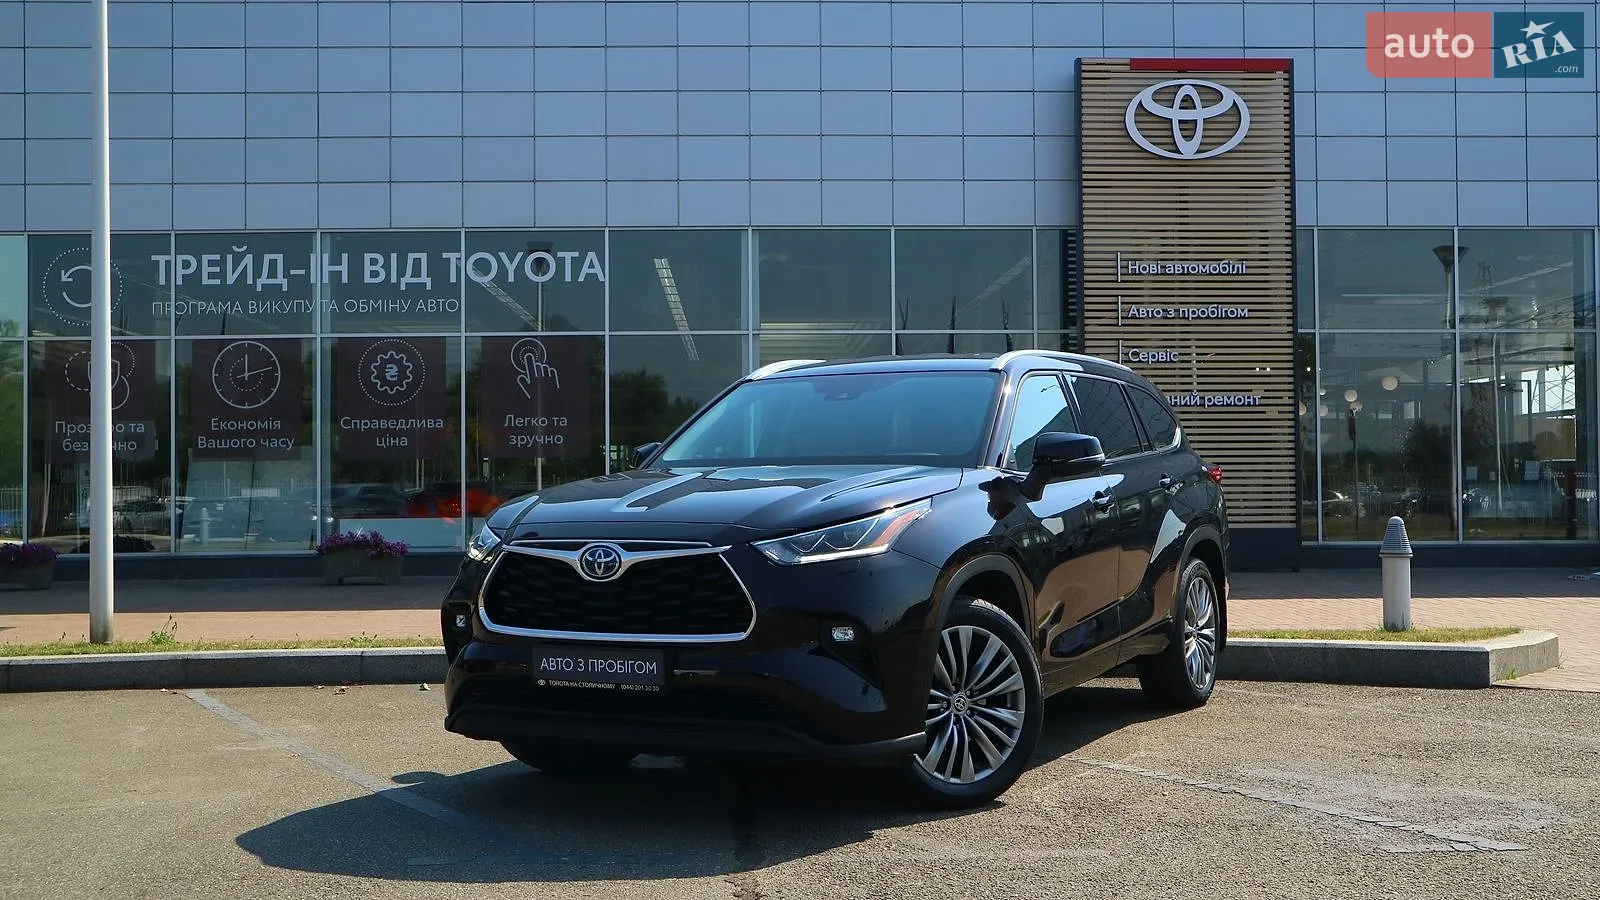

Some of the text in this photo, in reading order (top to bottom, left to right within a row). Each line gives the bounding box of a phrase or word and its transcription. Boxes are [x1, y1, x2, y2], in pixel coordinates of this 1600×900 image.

[151, 245, 606, 292] ТРЕЙД-ІН ВІД TOYOTA
[1127, 260, 1247, 275] Нові автомобілі
[151, 298, 460, 316] ПРОГРАМА ВИКУПУ ТА ОБМІНУ АВТО
[1127, 303, 1249, 321] Авто з пробігом
[1127, 348, 1180, 365] Сервіс
[1204, 395, 1262, 409] ремонт
[55, 420, 145, 437] Прозо та
[211, 416, 282, 431] Економія
[340, 416, 444, 432] Справедлива
[503, 414, 568, 428] Легко та
[62, 438, 137, 452] безчно
[198, 436, 296, 451] Вашого часу
[376, 434, 408, 448] ціна
[508, 434, 564, 448] зручно
[540, 657, 657, 675] АВТО З ПРОБІГОМ
